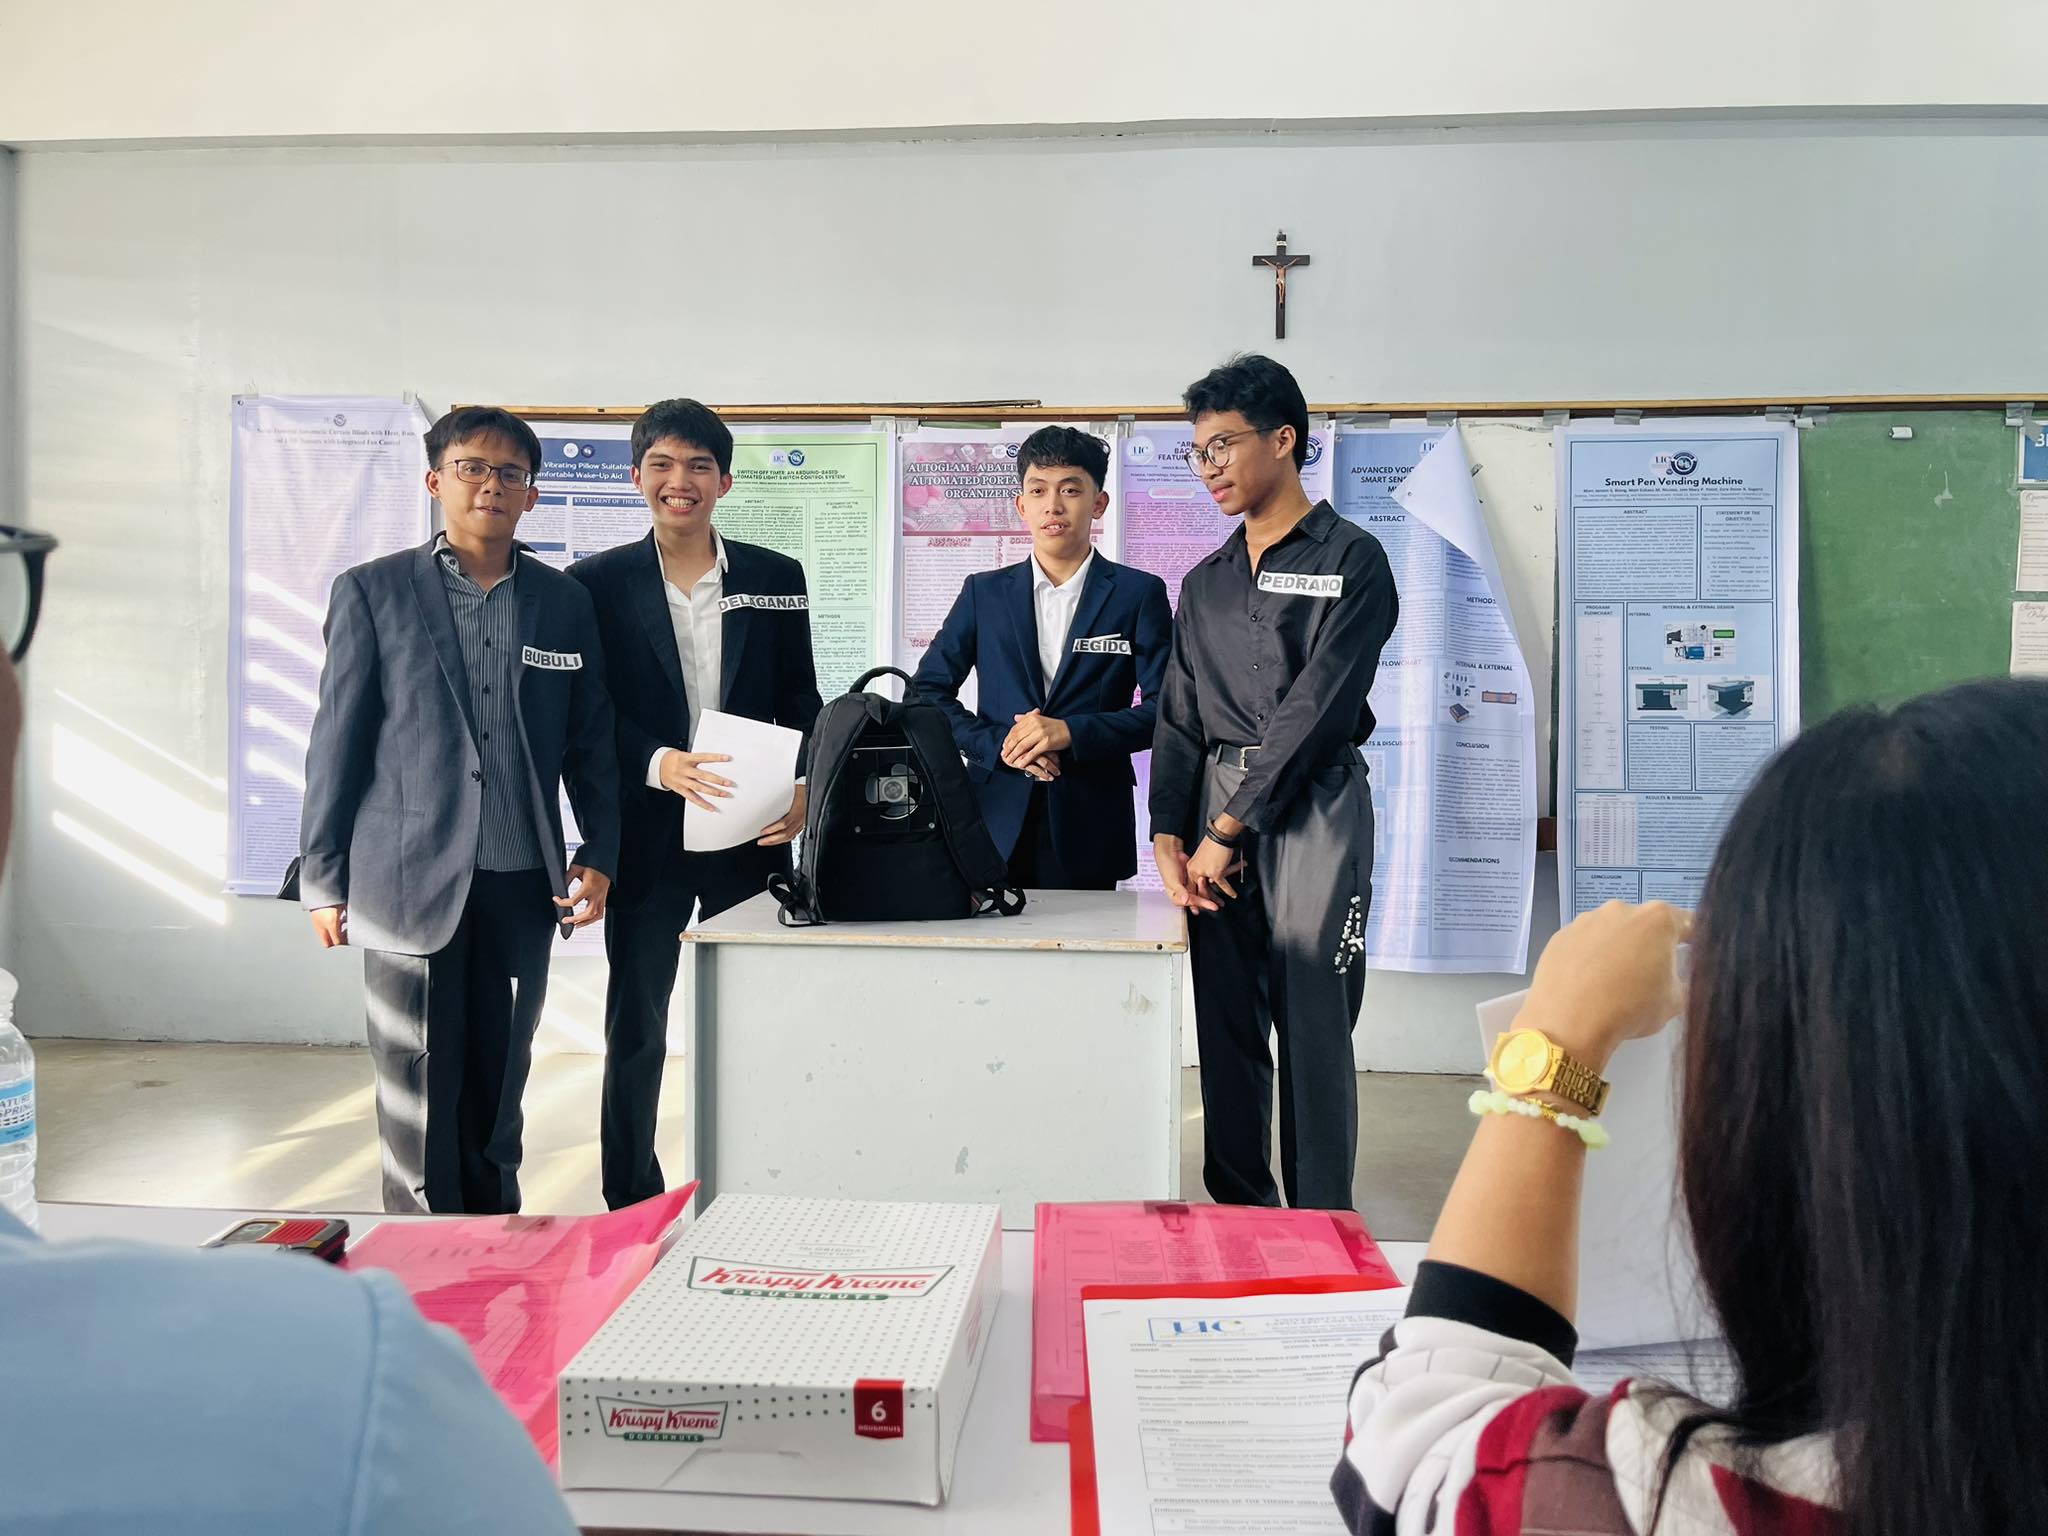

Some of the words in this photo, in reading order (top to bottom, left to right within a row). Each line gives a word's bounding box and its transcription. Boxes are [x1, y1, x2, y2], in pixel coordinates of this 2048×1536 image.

[544, 461, 577, 470] Vibrating
[578, 462, 600, 470] Pillow
[908, 463, 970, 472] AUTOGLAM
[575, 472, 610, 480] Wake-Up
[912, 476, 983, 486] AUTOMATED
[1604, 478, 1636, 486] Smart
[1638, 478, 1656, 486] Pen
[1658, 477, 1700, 487] Vending
[1702, 477, 1743, 486] Machine
[945, 488, 1009, 498] ORGANIZER
[1260, 574, 1341, 591] PEDRANO
[524, 650, 579, 668] BUBULI
[1456, 741, 1490, 749] CONCLUSION
[700, 1266, 824, 1290] Krispy
[815, 1272, 936, 1290] Kreme
[732, 1288, 878, 1300] DOUGHNUTS
[871, 1400, 886, 1422] 6
[608, 1408, 665, 1432] Krispy
[665, 1409, 721, 1430] Kreme
[628, 1433, 698, 1441] DOUGHNUTS
